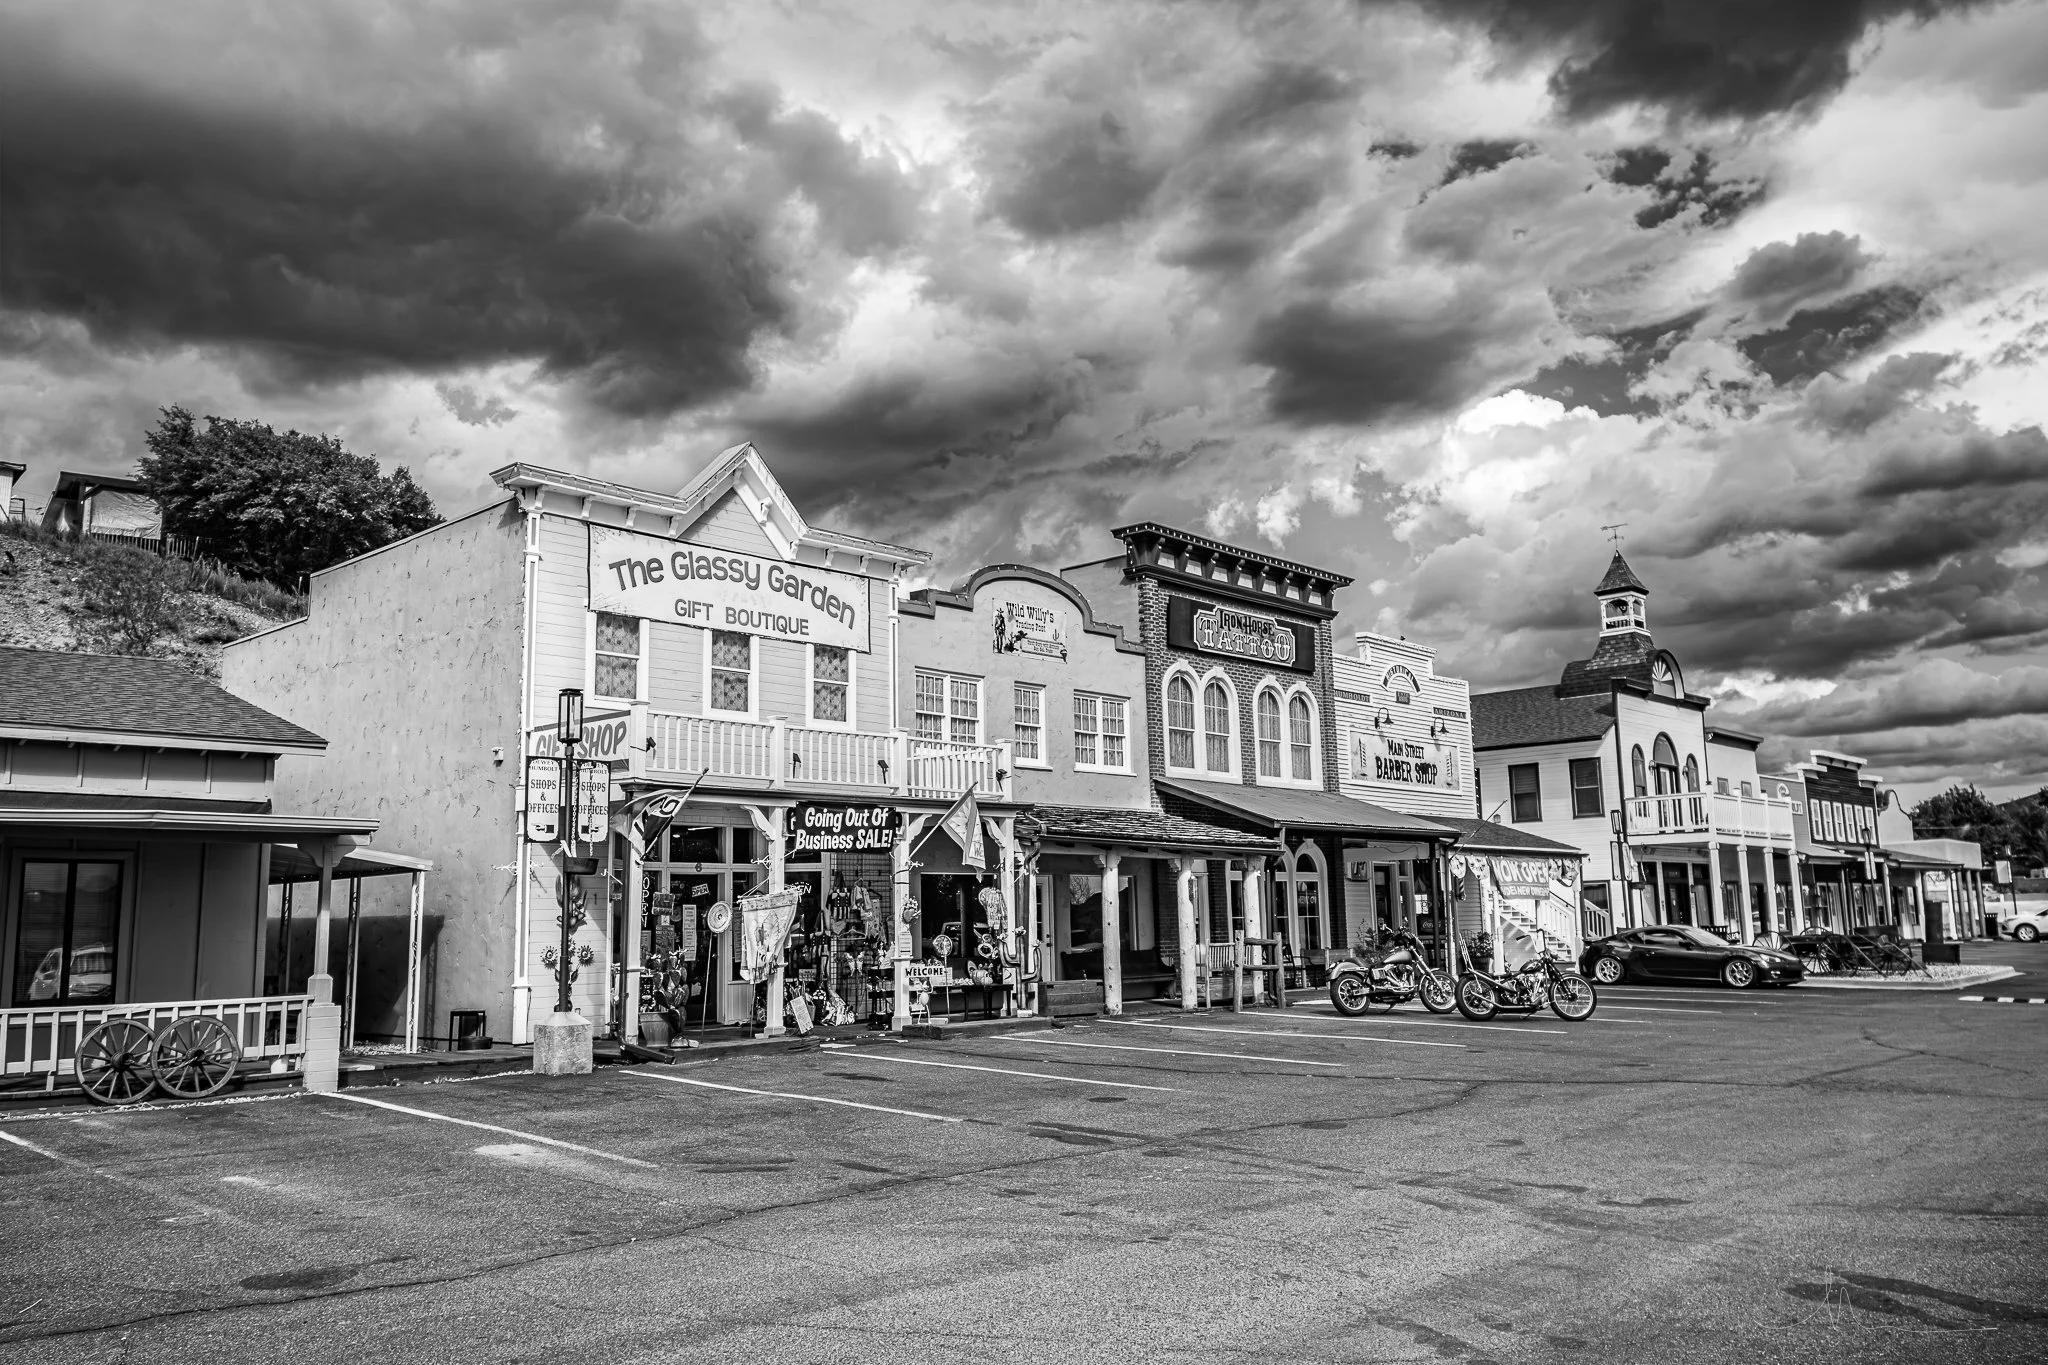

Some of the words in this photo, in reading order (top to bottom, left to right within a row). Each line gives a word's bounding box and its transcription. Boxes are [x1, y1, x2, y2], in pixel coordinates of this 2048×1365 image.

[608, 557, 664, 591] The
[670, 551, 761, 591] Glassy
[767, 565, 855, 630] Garden
[674, 599, 713, 621] GIFT
[725, 606, 809, 636] BOUTIQUE
[1006, 602, 1025, 618] Wild
[1026, 606, 1055, 625] Willy's
[1199, 616, 1291, 661] TATTOO
[1333, 689, 1370, 702] HUMBOLDT
[1433, 707, 1465, 719] ARIZONA
[577, 721, 627, 759] SHOP
[1404, 742, 1425, 760] STREET
[1375, 755, 1413, 783] BARBER
[1414, 762, 1438, 785] SHOP
[530, 779, 557, 790] SHOPS
[581, 781, 606, 793] SHOPS
[540, 792, 547, 802] &
[527, 803, 560, 814] OFFICES
[578, 804, 609, 816] OFFICES
[805, 807, 843, 833] Going
[845, 807, 870, 827] Out
[871, 807, 889, 827] Of
[796, 828, 854, 850] Business
[856, 828, 893, 850] SALE!
[1490, 859, 1523, 882] NOW
[1521, 861, 1549, 883] OPEN
[640, 876, 650, 928] OPEN
[905, 967, 944, 976] WELCOME
